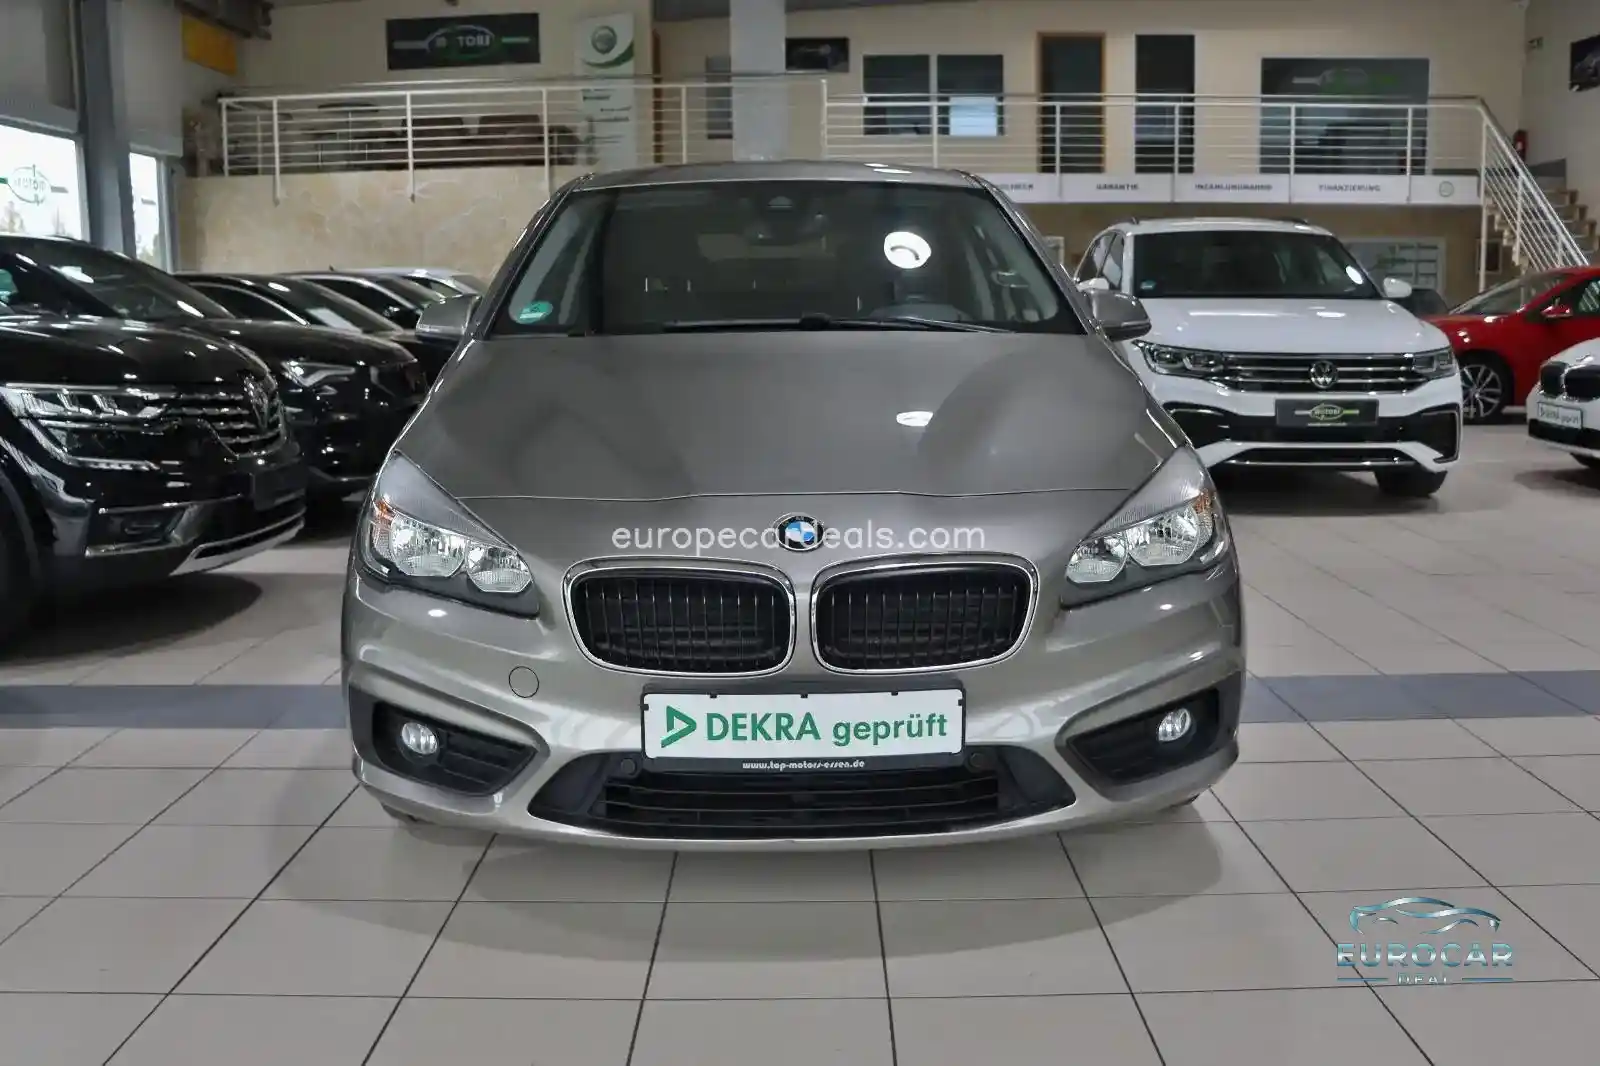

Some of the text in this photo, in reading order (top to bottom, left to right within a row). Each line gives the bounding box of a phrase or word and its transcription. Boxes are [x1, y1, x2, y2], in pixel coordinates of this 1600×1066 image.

[706, 712, 948, 747] DEKRA geprüft
[742, 758, 866, 771] www.top-motors-essen.de
